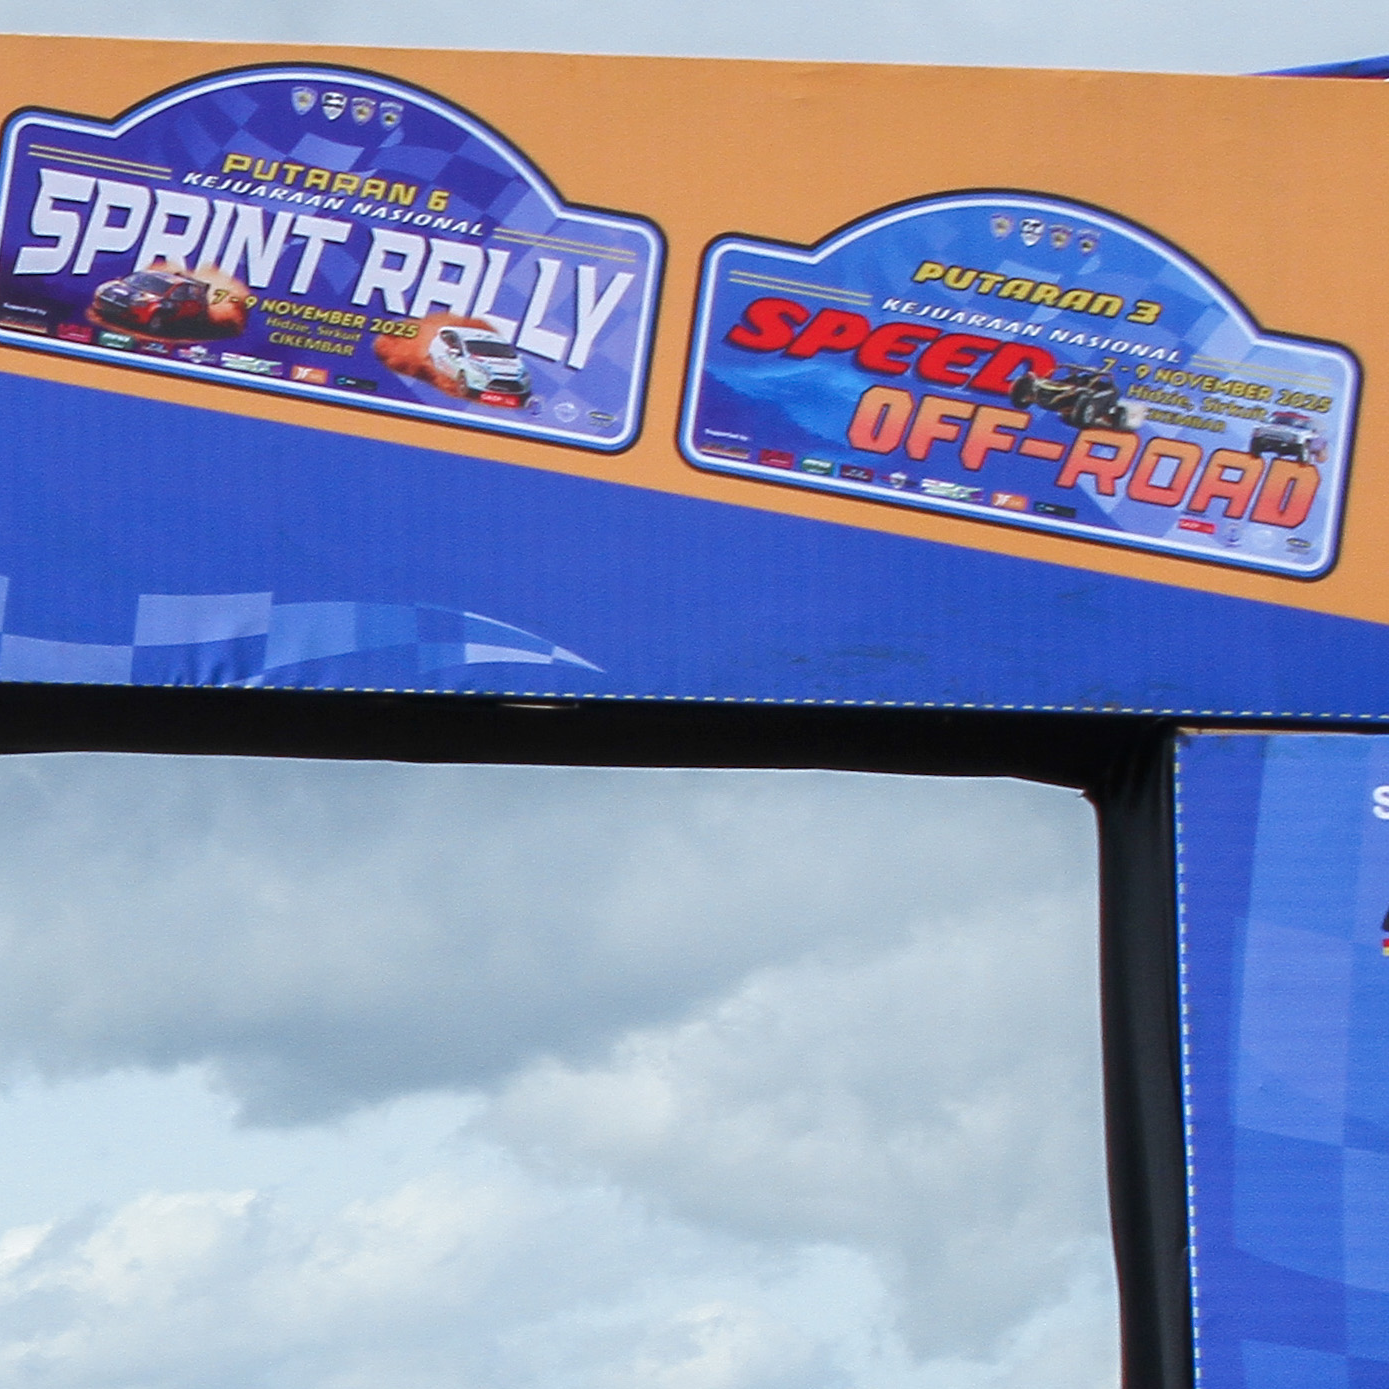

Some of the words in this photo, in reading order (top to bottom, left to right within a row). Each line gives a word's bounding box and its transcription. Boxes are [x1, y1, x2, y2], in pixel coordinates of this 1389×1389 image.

[182, 171, 346, 210] KEJUARAAN
[349, 202, 484, 236] NASIONAL
[222, 152, 419, 206] PUTARAN
[426, 188, 451, 212] 6
[12, 166, 350, 296] SPRINT
[351, 228, 636, 373] RALLY
[912, 260, 1125, 319] PUTARAN
[1126, 299, 1163, 326] 3
[261, 299, 366, 329] NOVEMBER
[371, 317, 420, 339] 2025
[268, 331, 356, 357] CIKEMBAR
[726, 295, 1059, 396] SPEED
[882, 297, 1043, 338] KEJUARAAN
[1048, 327, 1182, 364] NASIONAL
[1153, 368, 1273, 401] NOVEMBER
[846, 384, 1323, 529] OFF-ROAD
